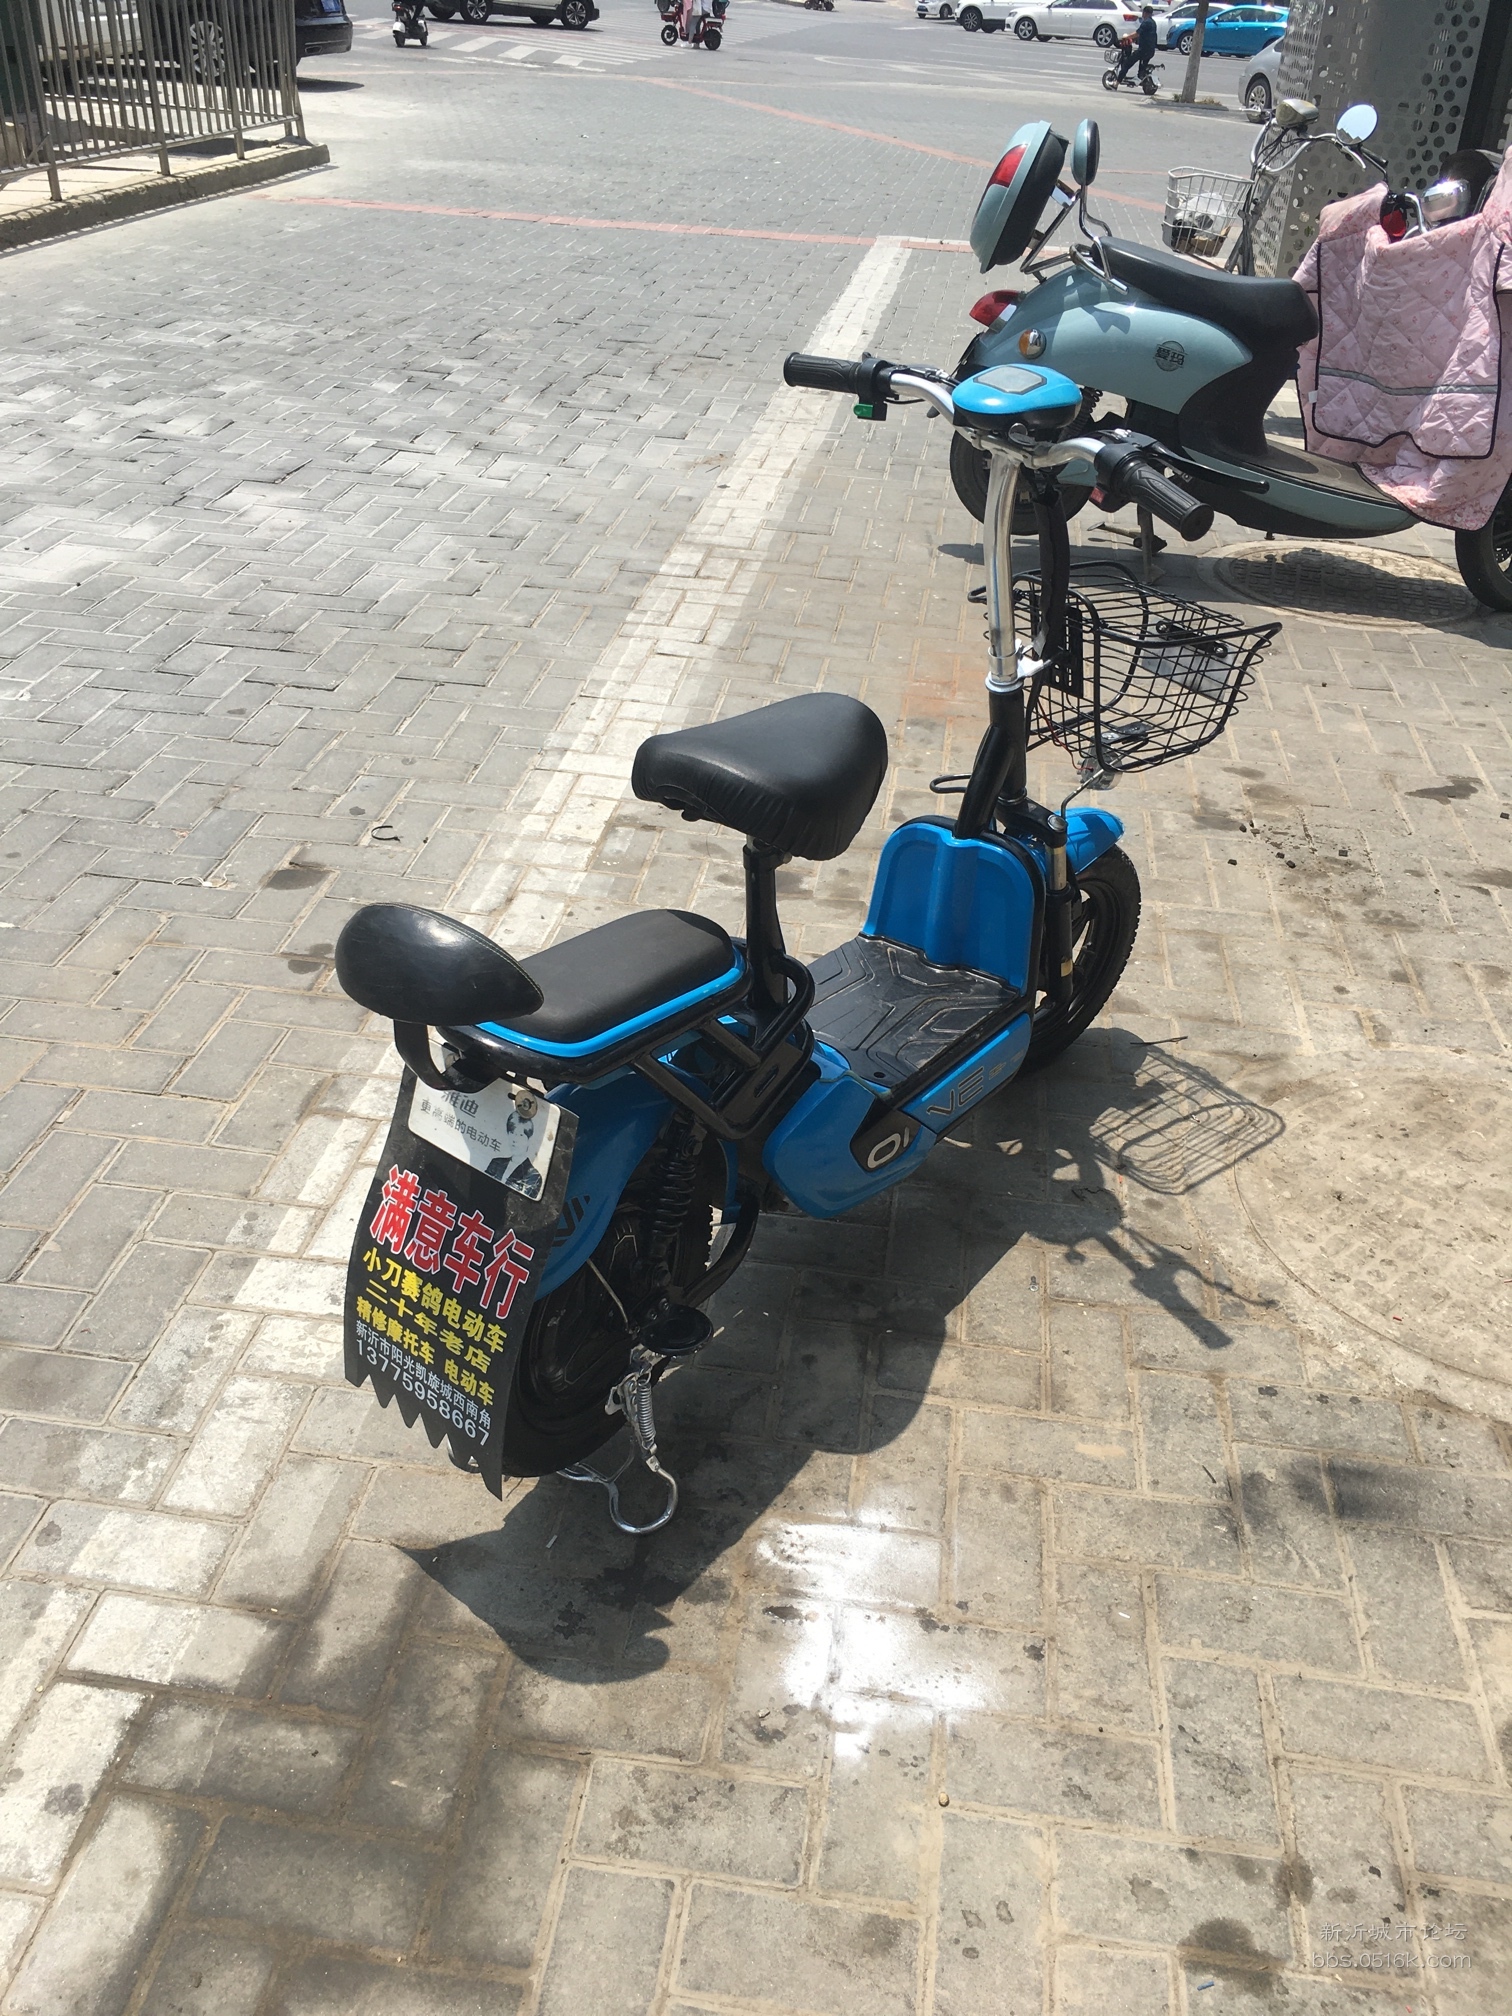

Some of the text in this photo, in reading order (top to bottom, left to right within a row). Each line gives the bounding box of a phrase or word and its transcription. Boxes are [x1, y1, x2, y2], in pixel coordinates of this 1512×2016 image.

[1154, 346, 1185, 366] 爱玛
[369, 1164, 534, 1320] 满意车行
[356, 1296, 495, 1406] 精修摩托车 电动车
[363, 1247, 507, 1353] 小刀赛鸽电动车
[366, 1279, 492, 1374] 二十年老店
[355, 1319, 491, 1430] 新沂市阳光凯旋城西南角
[356, 1339, 489, 1446] 13775958667
